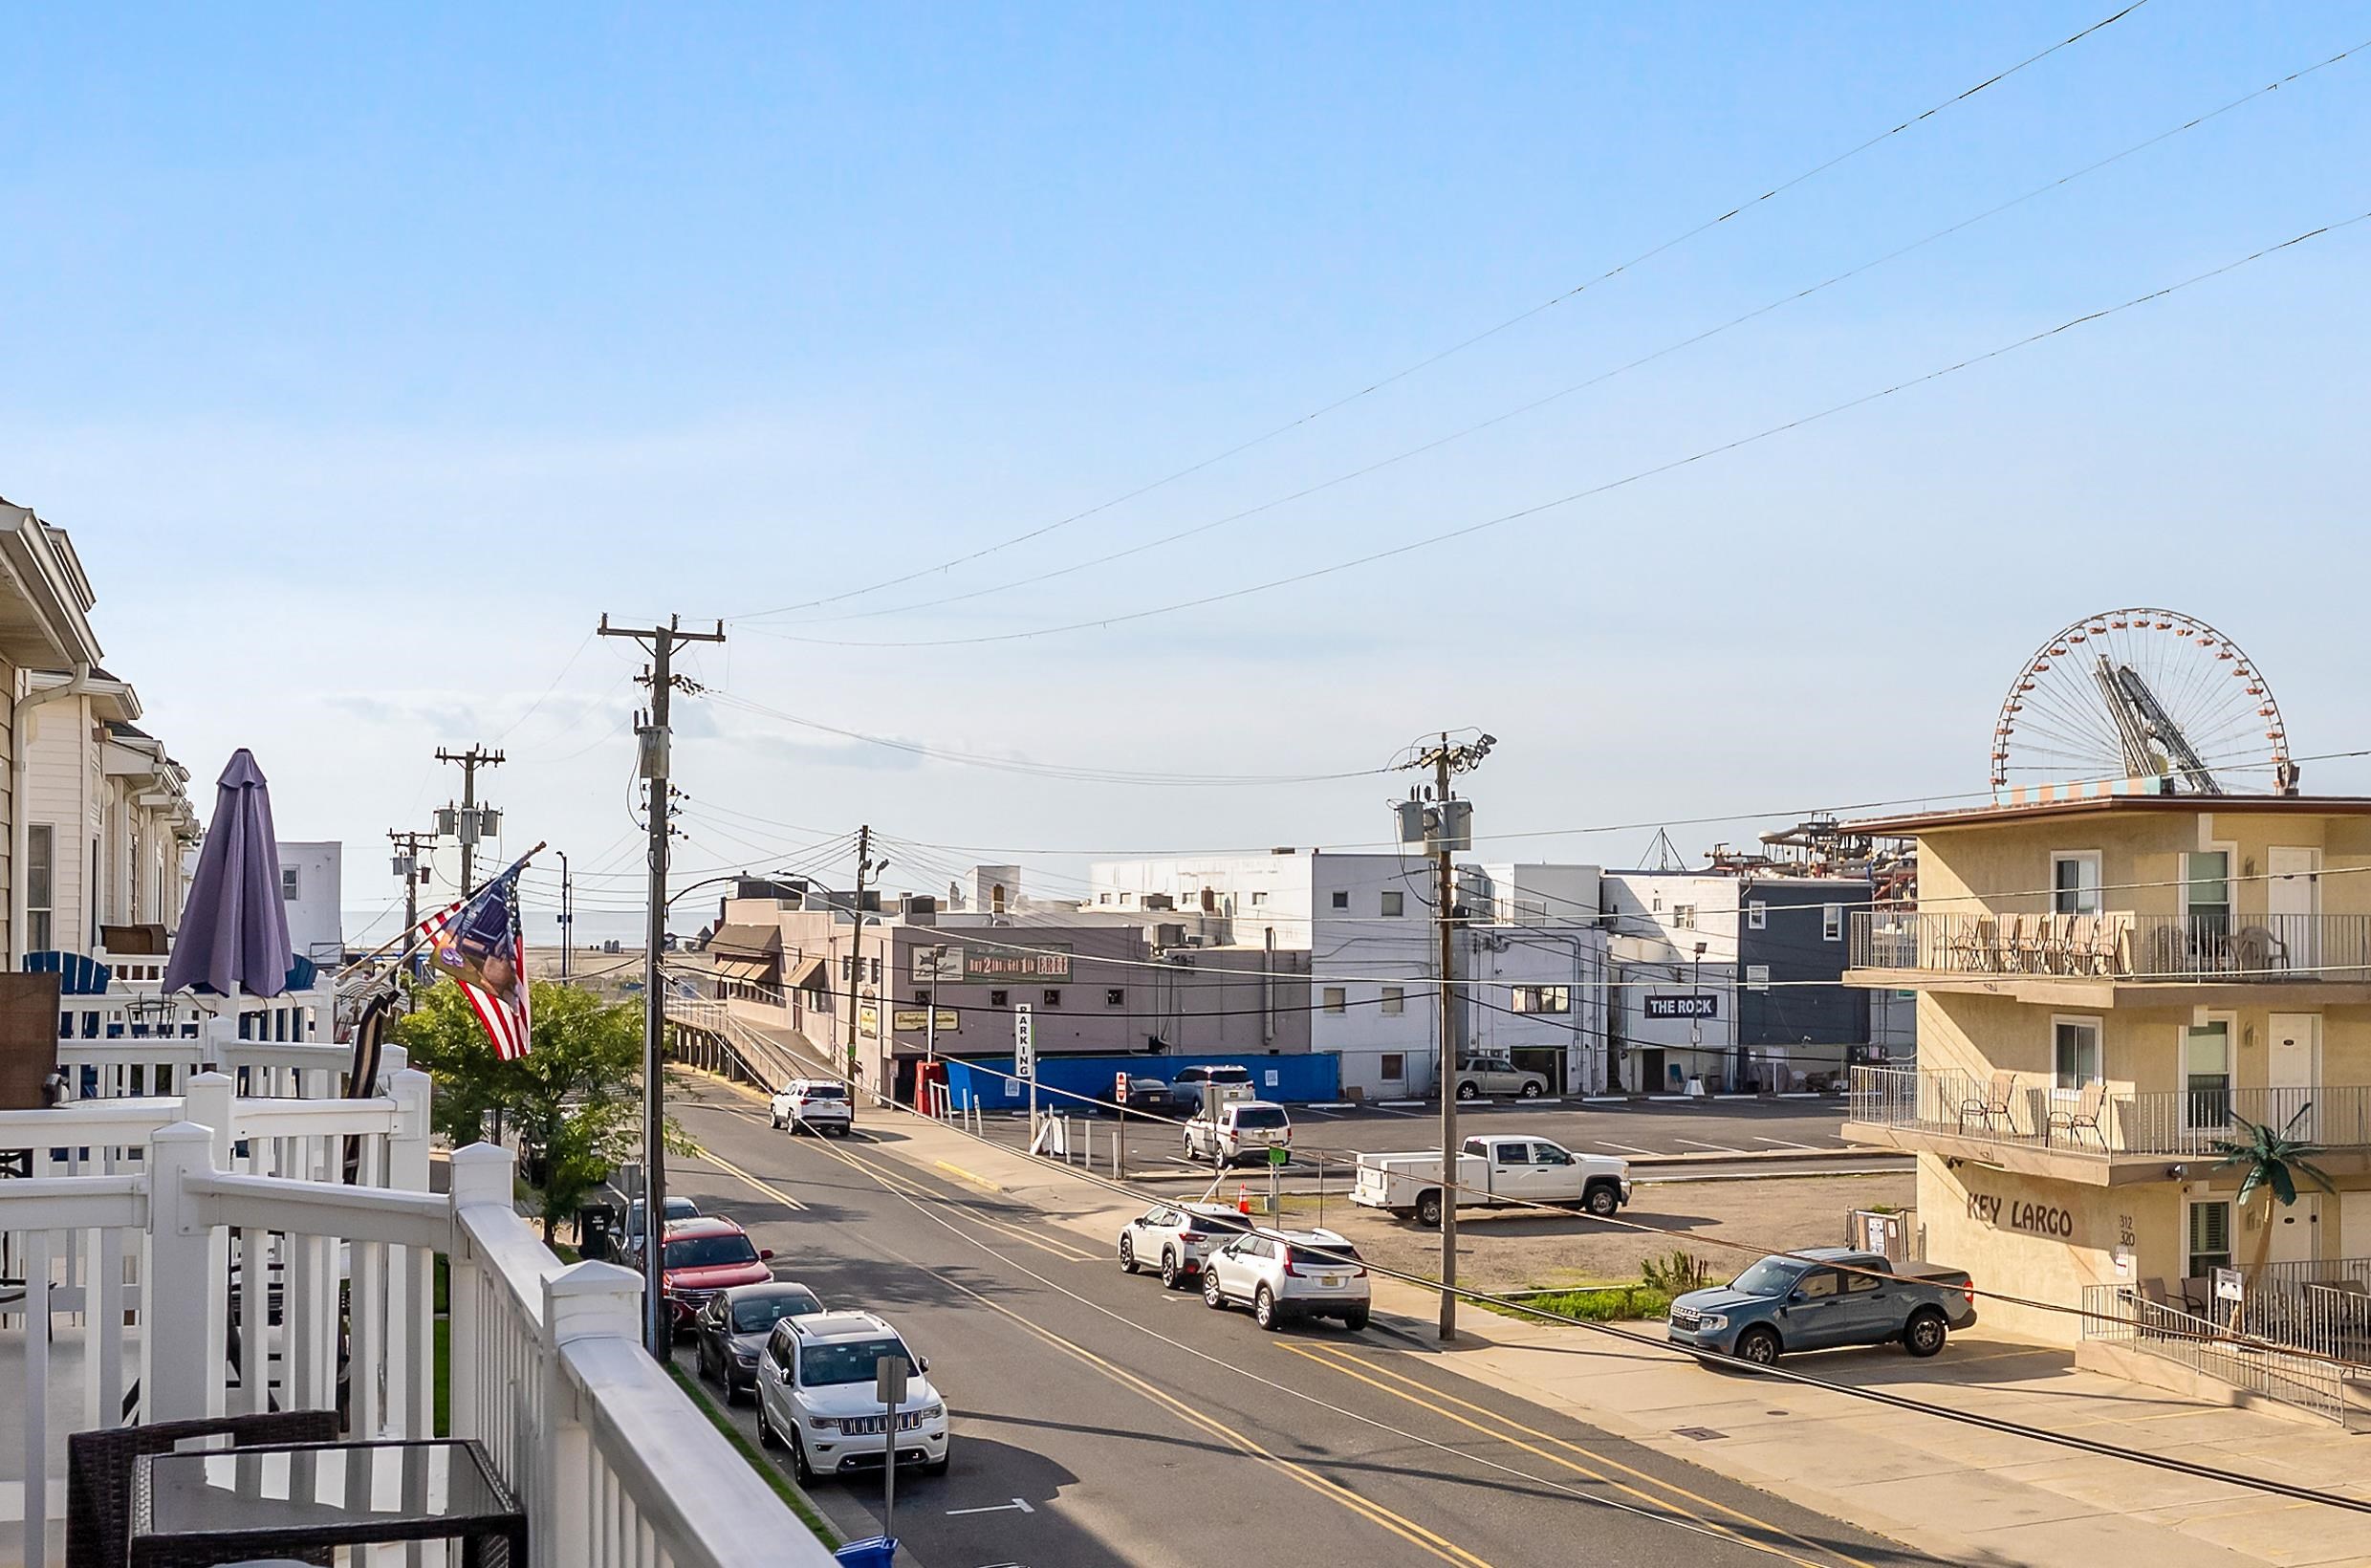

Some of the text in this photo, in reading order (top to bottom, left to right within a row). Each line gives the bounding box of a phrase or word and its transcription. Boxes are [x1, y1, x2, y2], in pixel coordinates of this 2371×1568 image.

[1038, 956, 1068, 975] FREE
[1650, 999, 1712, 1013] THE ROCK
[1019, 1007, 1029, 1075] PARKING
[1967, 1192, 2073, 1237] KEY LARGO
[2120, 1214, 2133, 1230] 312
[2121, 1230, 2136, 1247] 320
